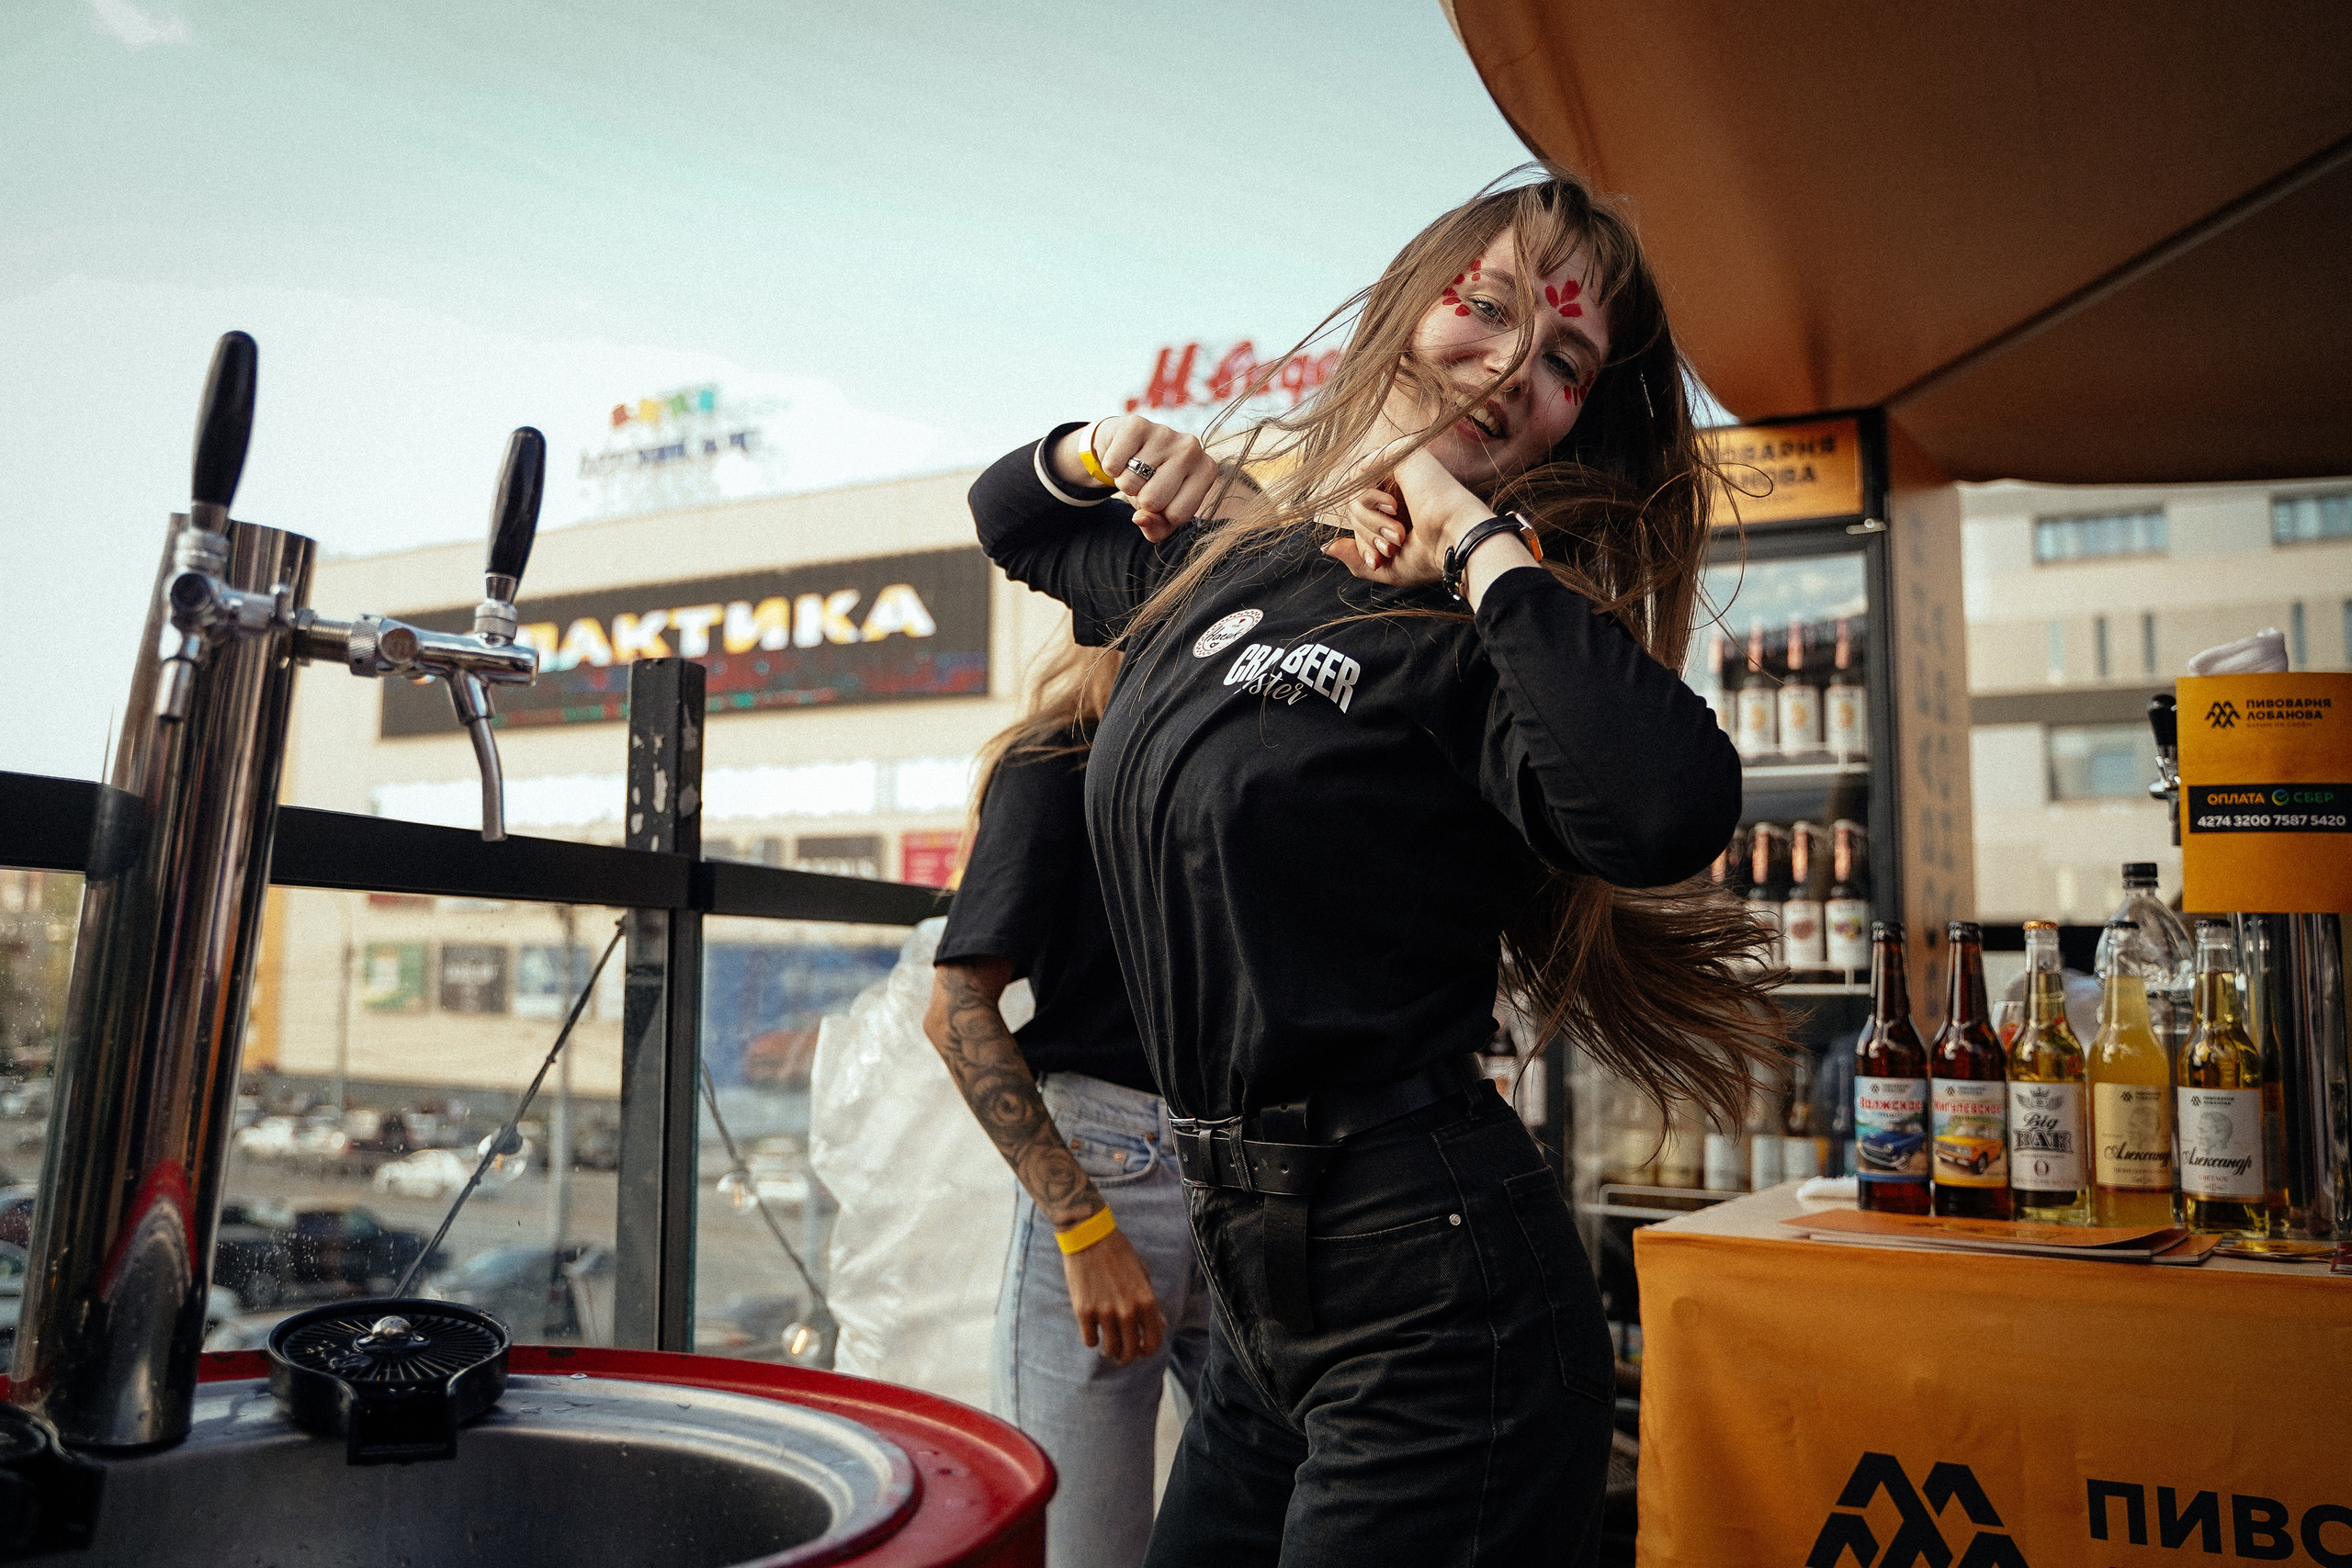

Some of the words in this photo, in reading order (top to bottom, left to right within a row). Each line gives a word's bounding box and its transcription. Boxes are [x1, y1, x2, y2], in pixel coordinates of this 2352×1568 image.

[1280, 643, 1361, 714] BEER
[2245, 698, 2332, 708] ПИВОВАРНЯ
[2246, 710, 2324, 720] ЛОБАНОВА
[2207, 793, 2266, 806] ОПЛАТА
[2293, 792, 2335, 804] СБЕР
[2197, 815, 2232, 827] 4274
[2233, 815, 2271, 827] 3200
[2273, 815, 2308, 826] 7587
[2310, 815, 2346, 826] 5420
[2023, 1112, 2059, 1130] Big
[2013, 1130, 2075, 1153] BAR
[2086, 1478, 2352, 1568] ПИВО
